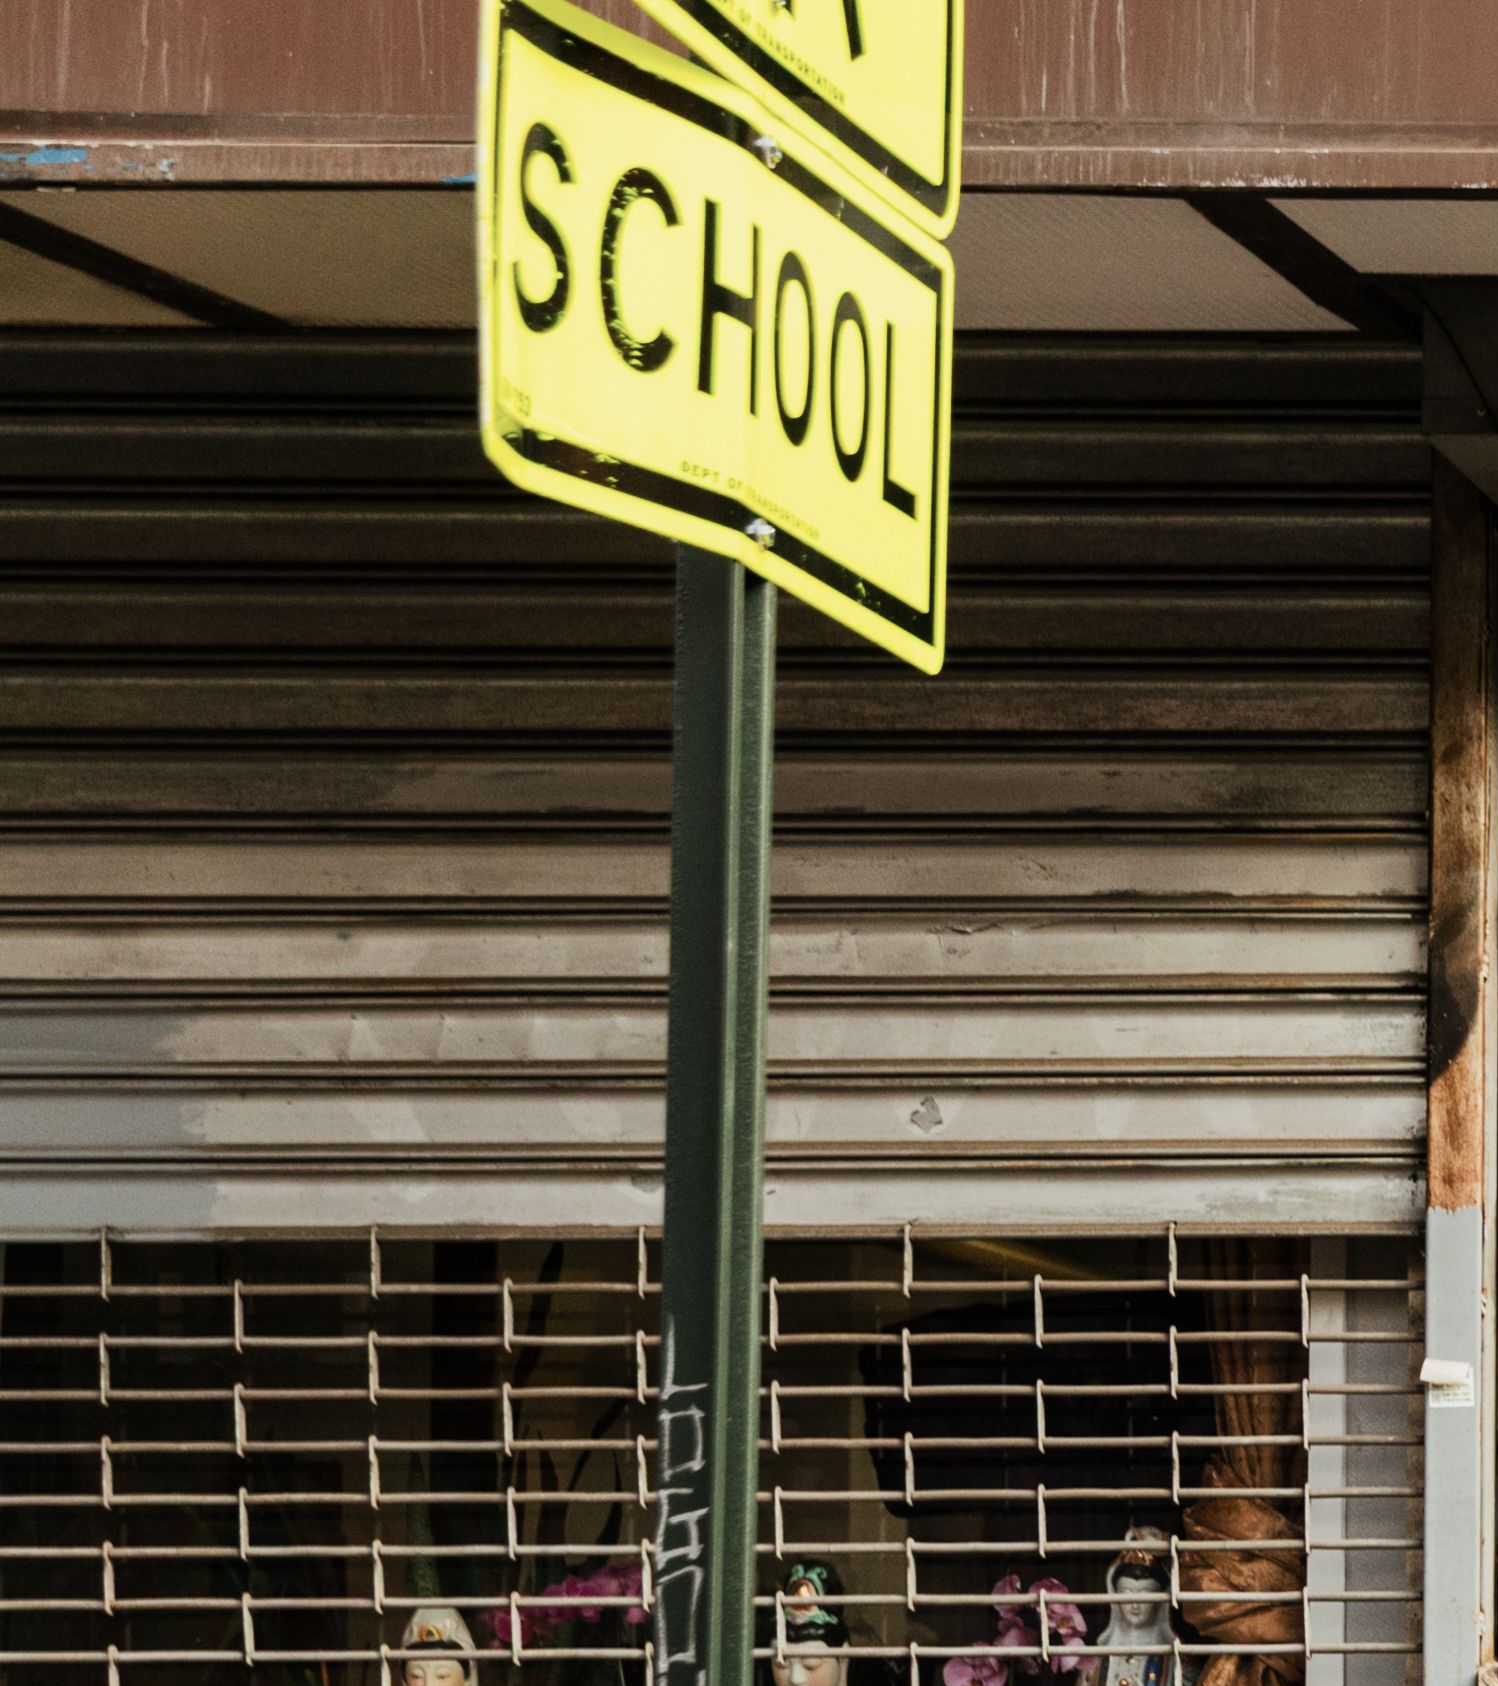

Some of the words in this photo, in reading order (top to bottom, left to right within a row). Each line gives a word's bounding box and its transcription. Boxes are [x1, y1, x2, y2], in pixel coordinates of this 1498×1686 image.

[512, 122, 918, 521] SCHOOL
[681, 461, 720, 484] DEPT
[728, 477, 743, 491] OF
